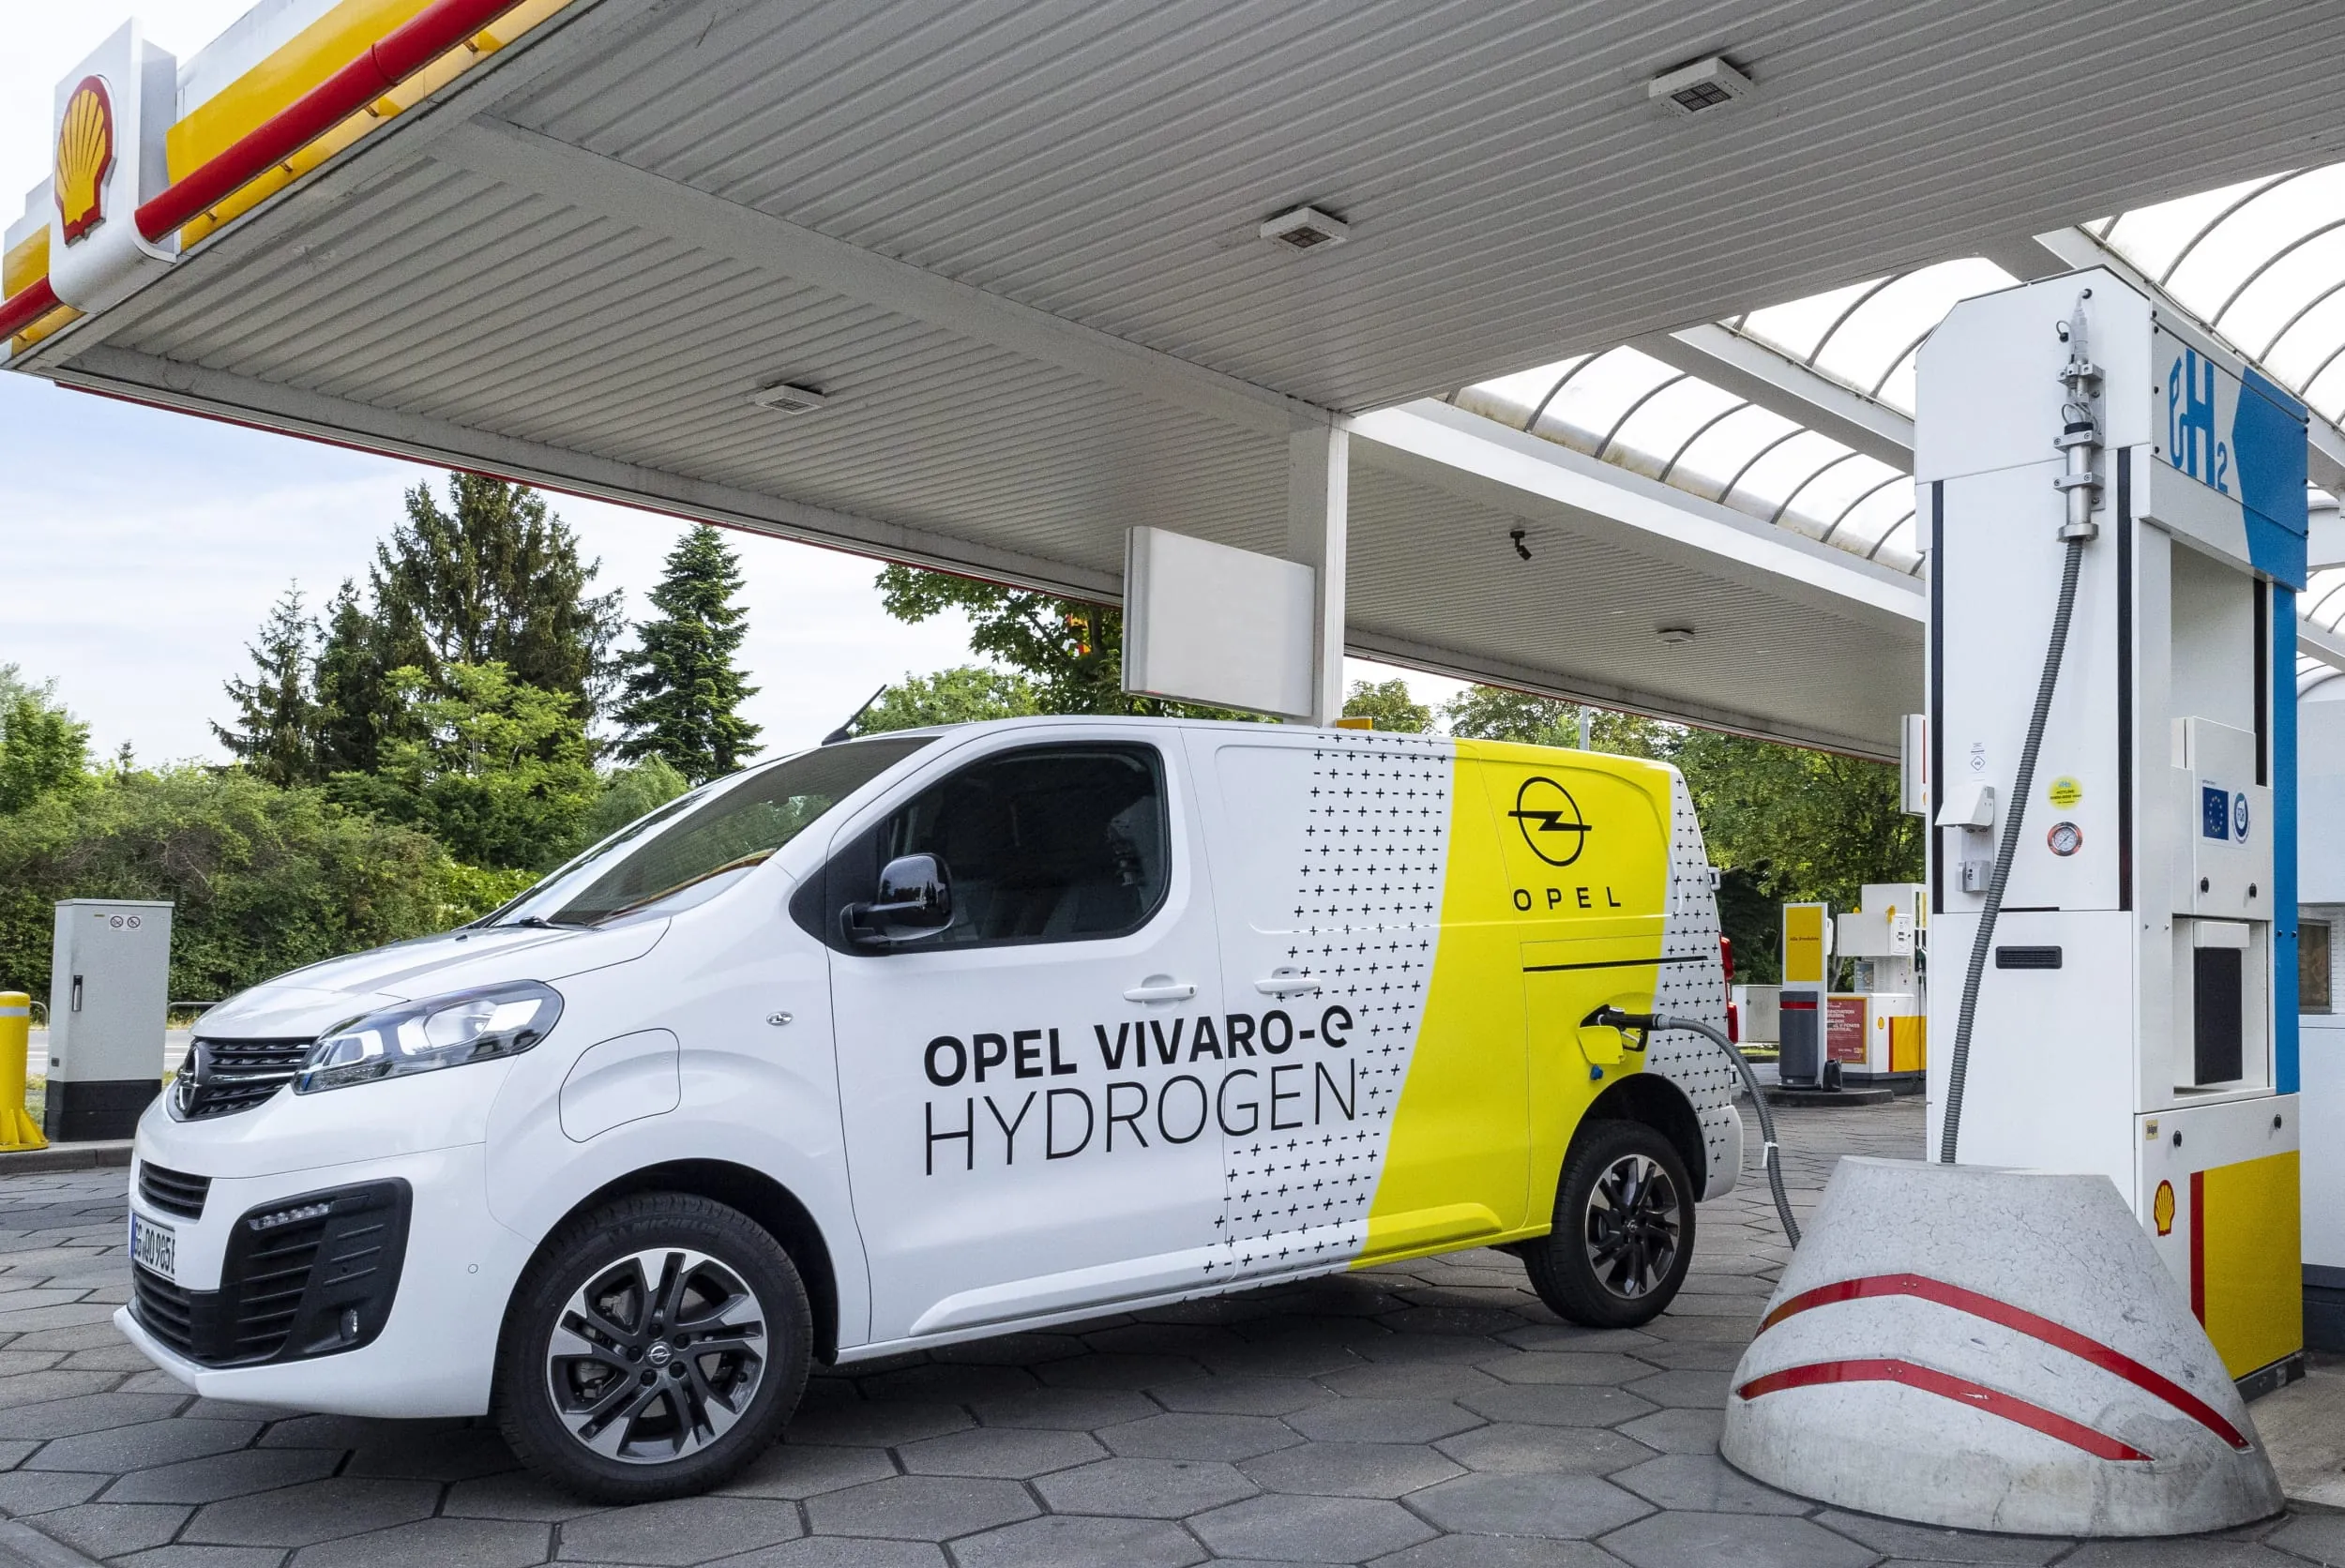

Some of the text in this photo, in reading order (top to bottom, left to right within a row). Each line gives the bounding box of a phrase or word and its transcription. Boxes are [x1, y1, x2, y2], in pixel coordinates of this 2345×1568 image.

[1513, 886, 1622, 912] OPEL
[924, 1004, 1354, 1087] OPEL VIVARO-e
[925, 1058, 1356, 1176] HYDROGEN
